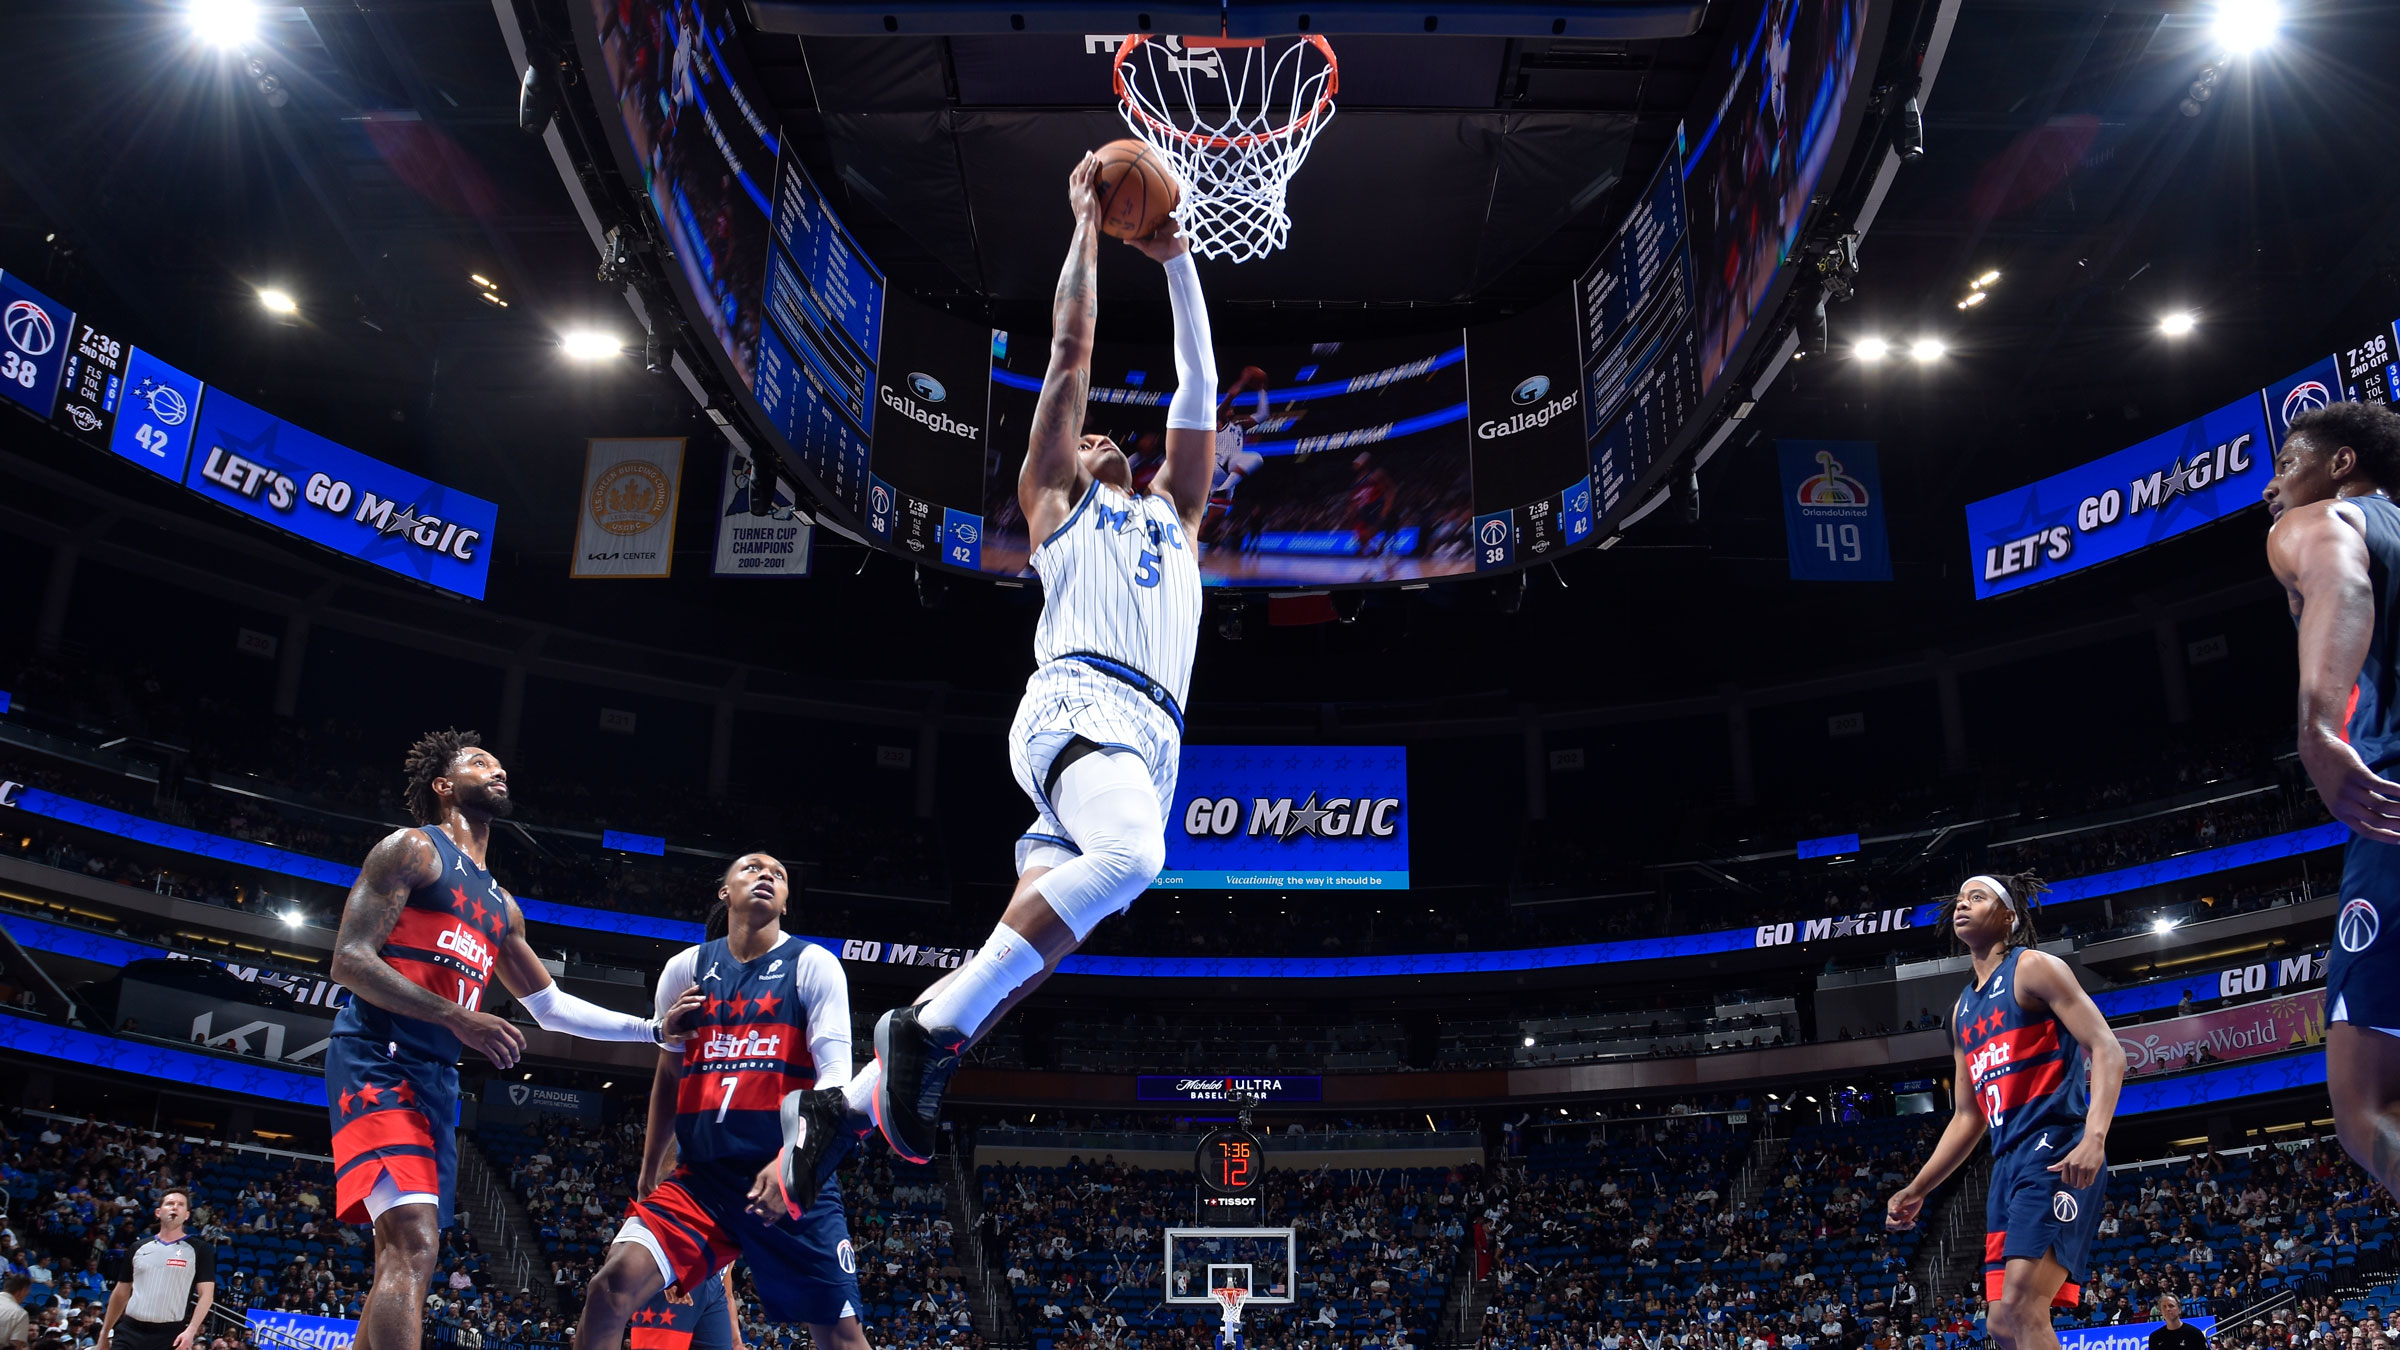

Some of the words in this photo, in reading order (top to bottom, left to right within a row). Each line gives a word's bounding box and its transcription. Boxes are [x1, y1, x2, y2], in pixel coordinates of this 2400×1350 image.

[81, 324, 122, 360] 7:36
[2346, 334, 2387, 368] 7:36
[0, 350, 38, 388] 38
[79, 343, 98, 360] 2ND
[99, 353, 117, 370] QTR
[2350, 363, 2369, 378] 2ND
[2370, 352, 2389, 368] QTR
[68, 366, 76, 378] 6
[84, 376, 100, 392] TOL
[108, 388, 116, 400] 6
[69, 356, 78, 367] 4
[86, 364, 102, 380] FLS
[110, 377, 118, 388] 3
[2348, 386, 2356, 396] 4
[2364, 374, 2381, 389] FLS
[2390, 364, 2397, 376] 3
[65, 377, 72, 388] 1
[80, 386, 98, 403] CHL
[106, 400, 113, 411] 1
[2366, 386, 2384, 399] TOL
[2392, 376, 2400, 386] 6
[880, 385, 979, 440] Gallagher
[1478, 389, 1579, 440] Gallagher
[134, 423, 168, 458] 42
[202, 445, 296, 512] LET'S
[305, 472, 352, 514] GO
[908, 498, 928, 514] 7:36
[1528, 500, 1549, 516] 7:36
[1802, 508, 1868, 518] OrlandoUnited
[733, 527, 775, 540] TURNER
[776, 527, 798, 540] CUP
[872, 514, 885, 533] 38
[1574, 516, 1588, 534] 42
[1984, 524, 2071, 582] LET'S
[2077, 489, 2120, 533] GO
[732, 541, 794, 555] CHAMPIONS
[952, 546, 970, 563] 42
[1486, 547, 1504, 564] 38
[1815, 523, 1862, 562] 49
[623, 552, 656, 560] CENTER
[738, 557, 786, 569] 2000-2001
[1134, 549, 1162, 588] 5
[1185, 797, 1239, 836] GO
[1226, 874, 1284, 887] Vacationing
[1287, 876, 1303, 885] the
[1306, 877, 1324, 887] way
[1326, 876, 1334, 885] it
[1335, 876, 1368, 885] should
[1369, 876, 1382, 885] be
[1755, 922, 1795, 948] GO
[434, 956, 450, 964] OF
[841, 938, 881, 962] GO
[2220, 963, 2267, 998] GO
[718, 1032, 734, 1040] THE
[2209, 1018, 2281, 1053] World
[716, 1062, 774, 1070] OLUMBIA
[534, 1090, 580, 1103] FANDUEL
[1176, 1080, 1224, 1090] Michelob
[1235, 1080, 1282, 1090] ULTRA
[715, 1076, 738, 1124] 7
[1218, 1143, 1250, 1158] 7:36
[1224, 1159, 1248, 1186] 12
[1218, 1198, 1256, 1206] TISSOT
